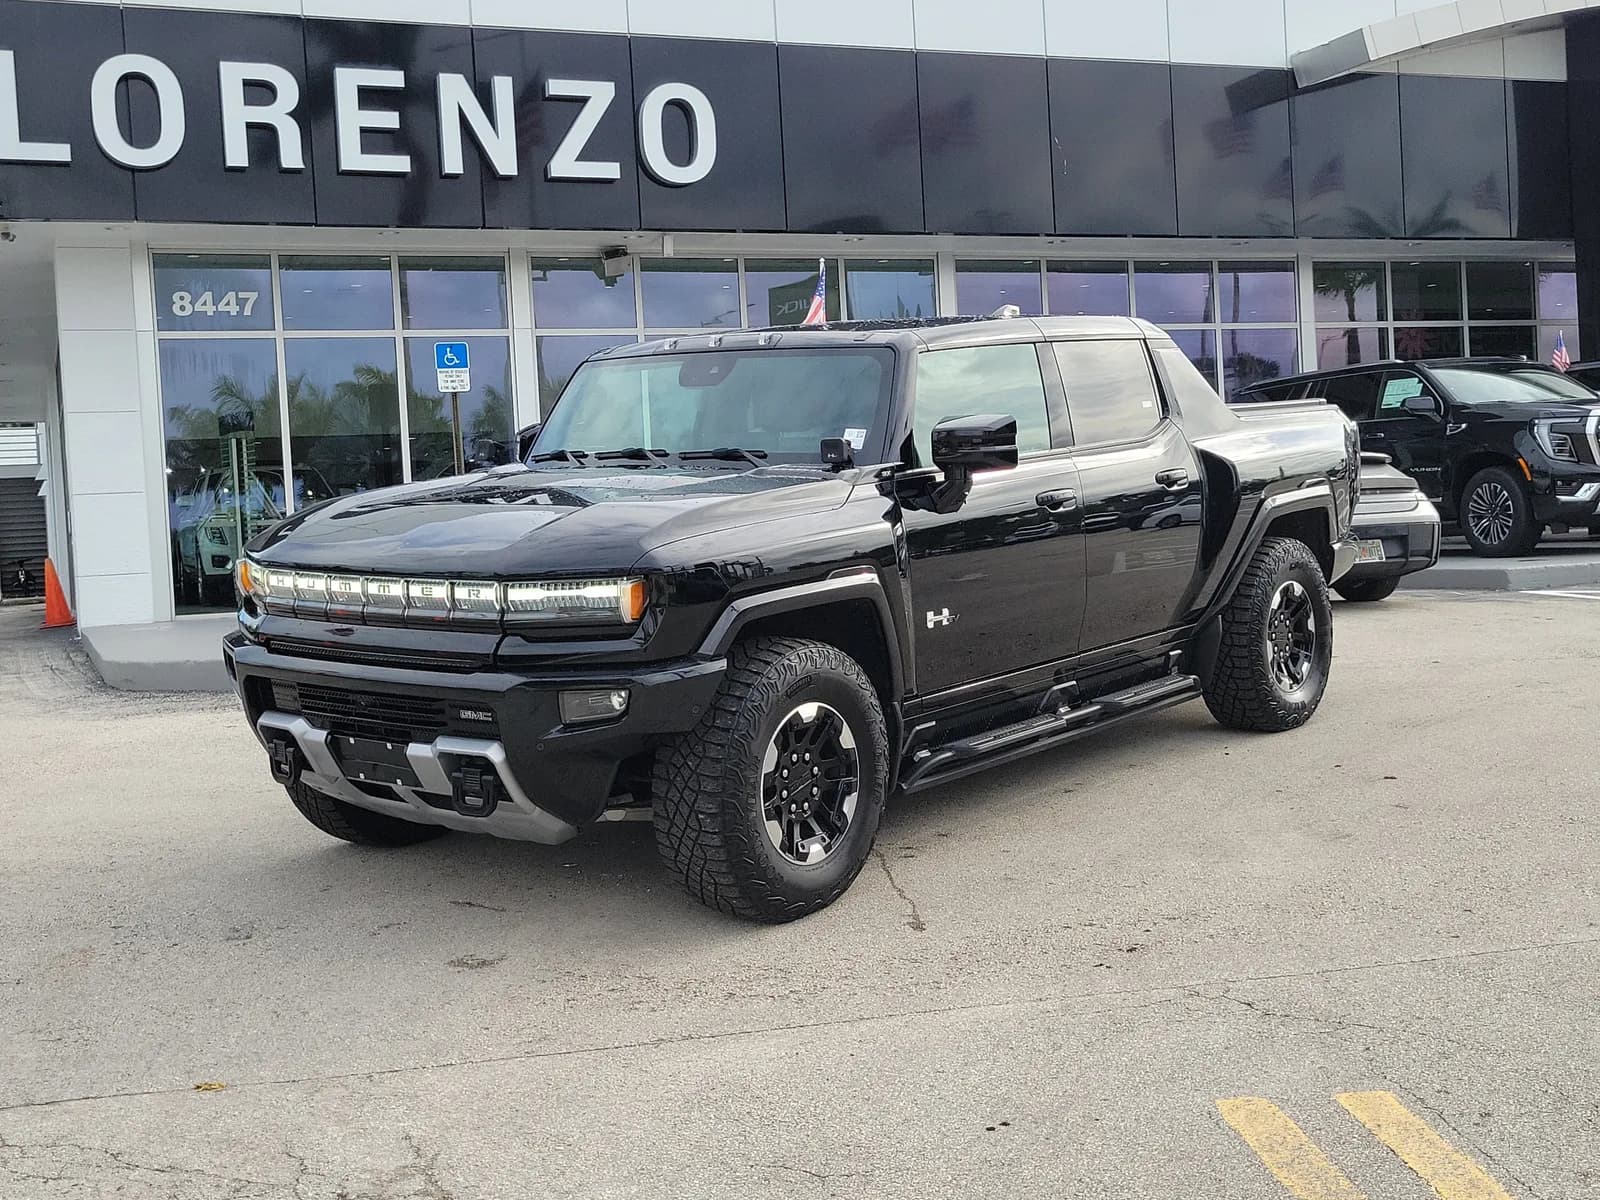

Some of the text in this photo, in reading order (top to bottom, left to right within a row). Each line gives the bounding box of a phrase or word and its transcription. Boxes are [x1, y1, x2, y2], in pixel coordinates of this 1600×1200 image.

[0, 50, 717, 187] LORENZO
[172, 291, 258, 316] 8447
[276, 575, 481, 599] HUMMER
[460, 710, 492, 721] GMC
